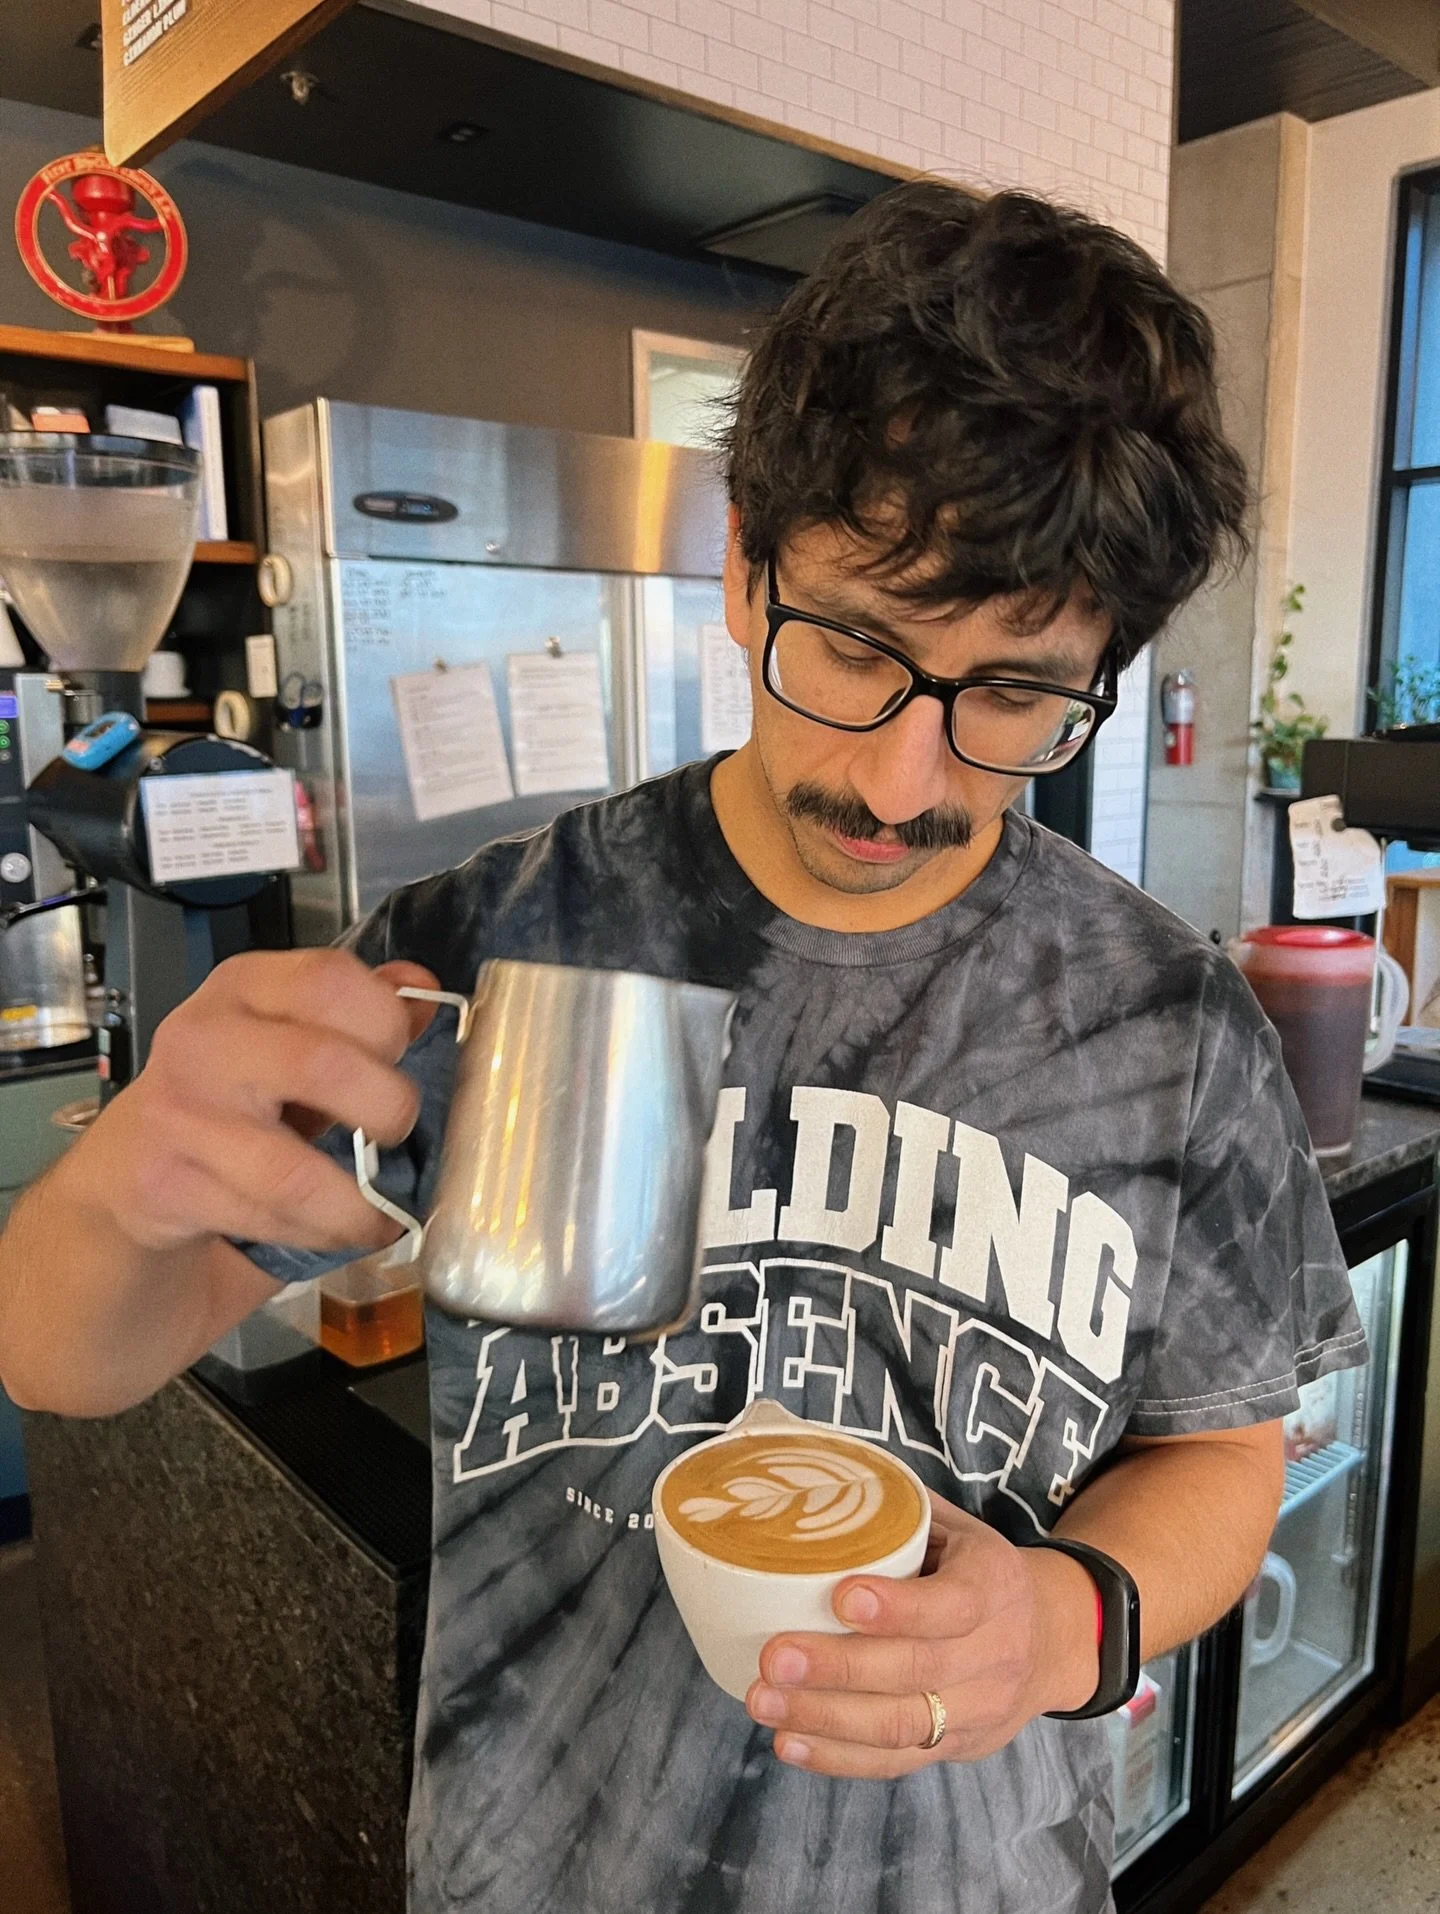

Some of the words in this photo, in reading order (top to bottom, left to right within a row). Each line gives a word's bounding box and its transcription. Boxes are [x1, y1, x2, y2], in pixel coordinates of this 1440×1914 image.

[702, 1086, 1138, 1384] LDING
[566, 1486, 615, 1524] SINCE
[627, 1513, 655, 1529] 20
